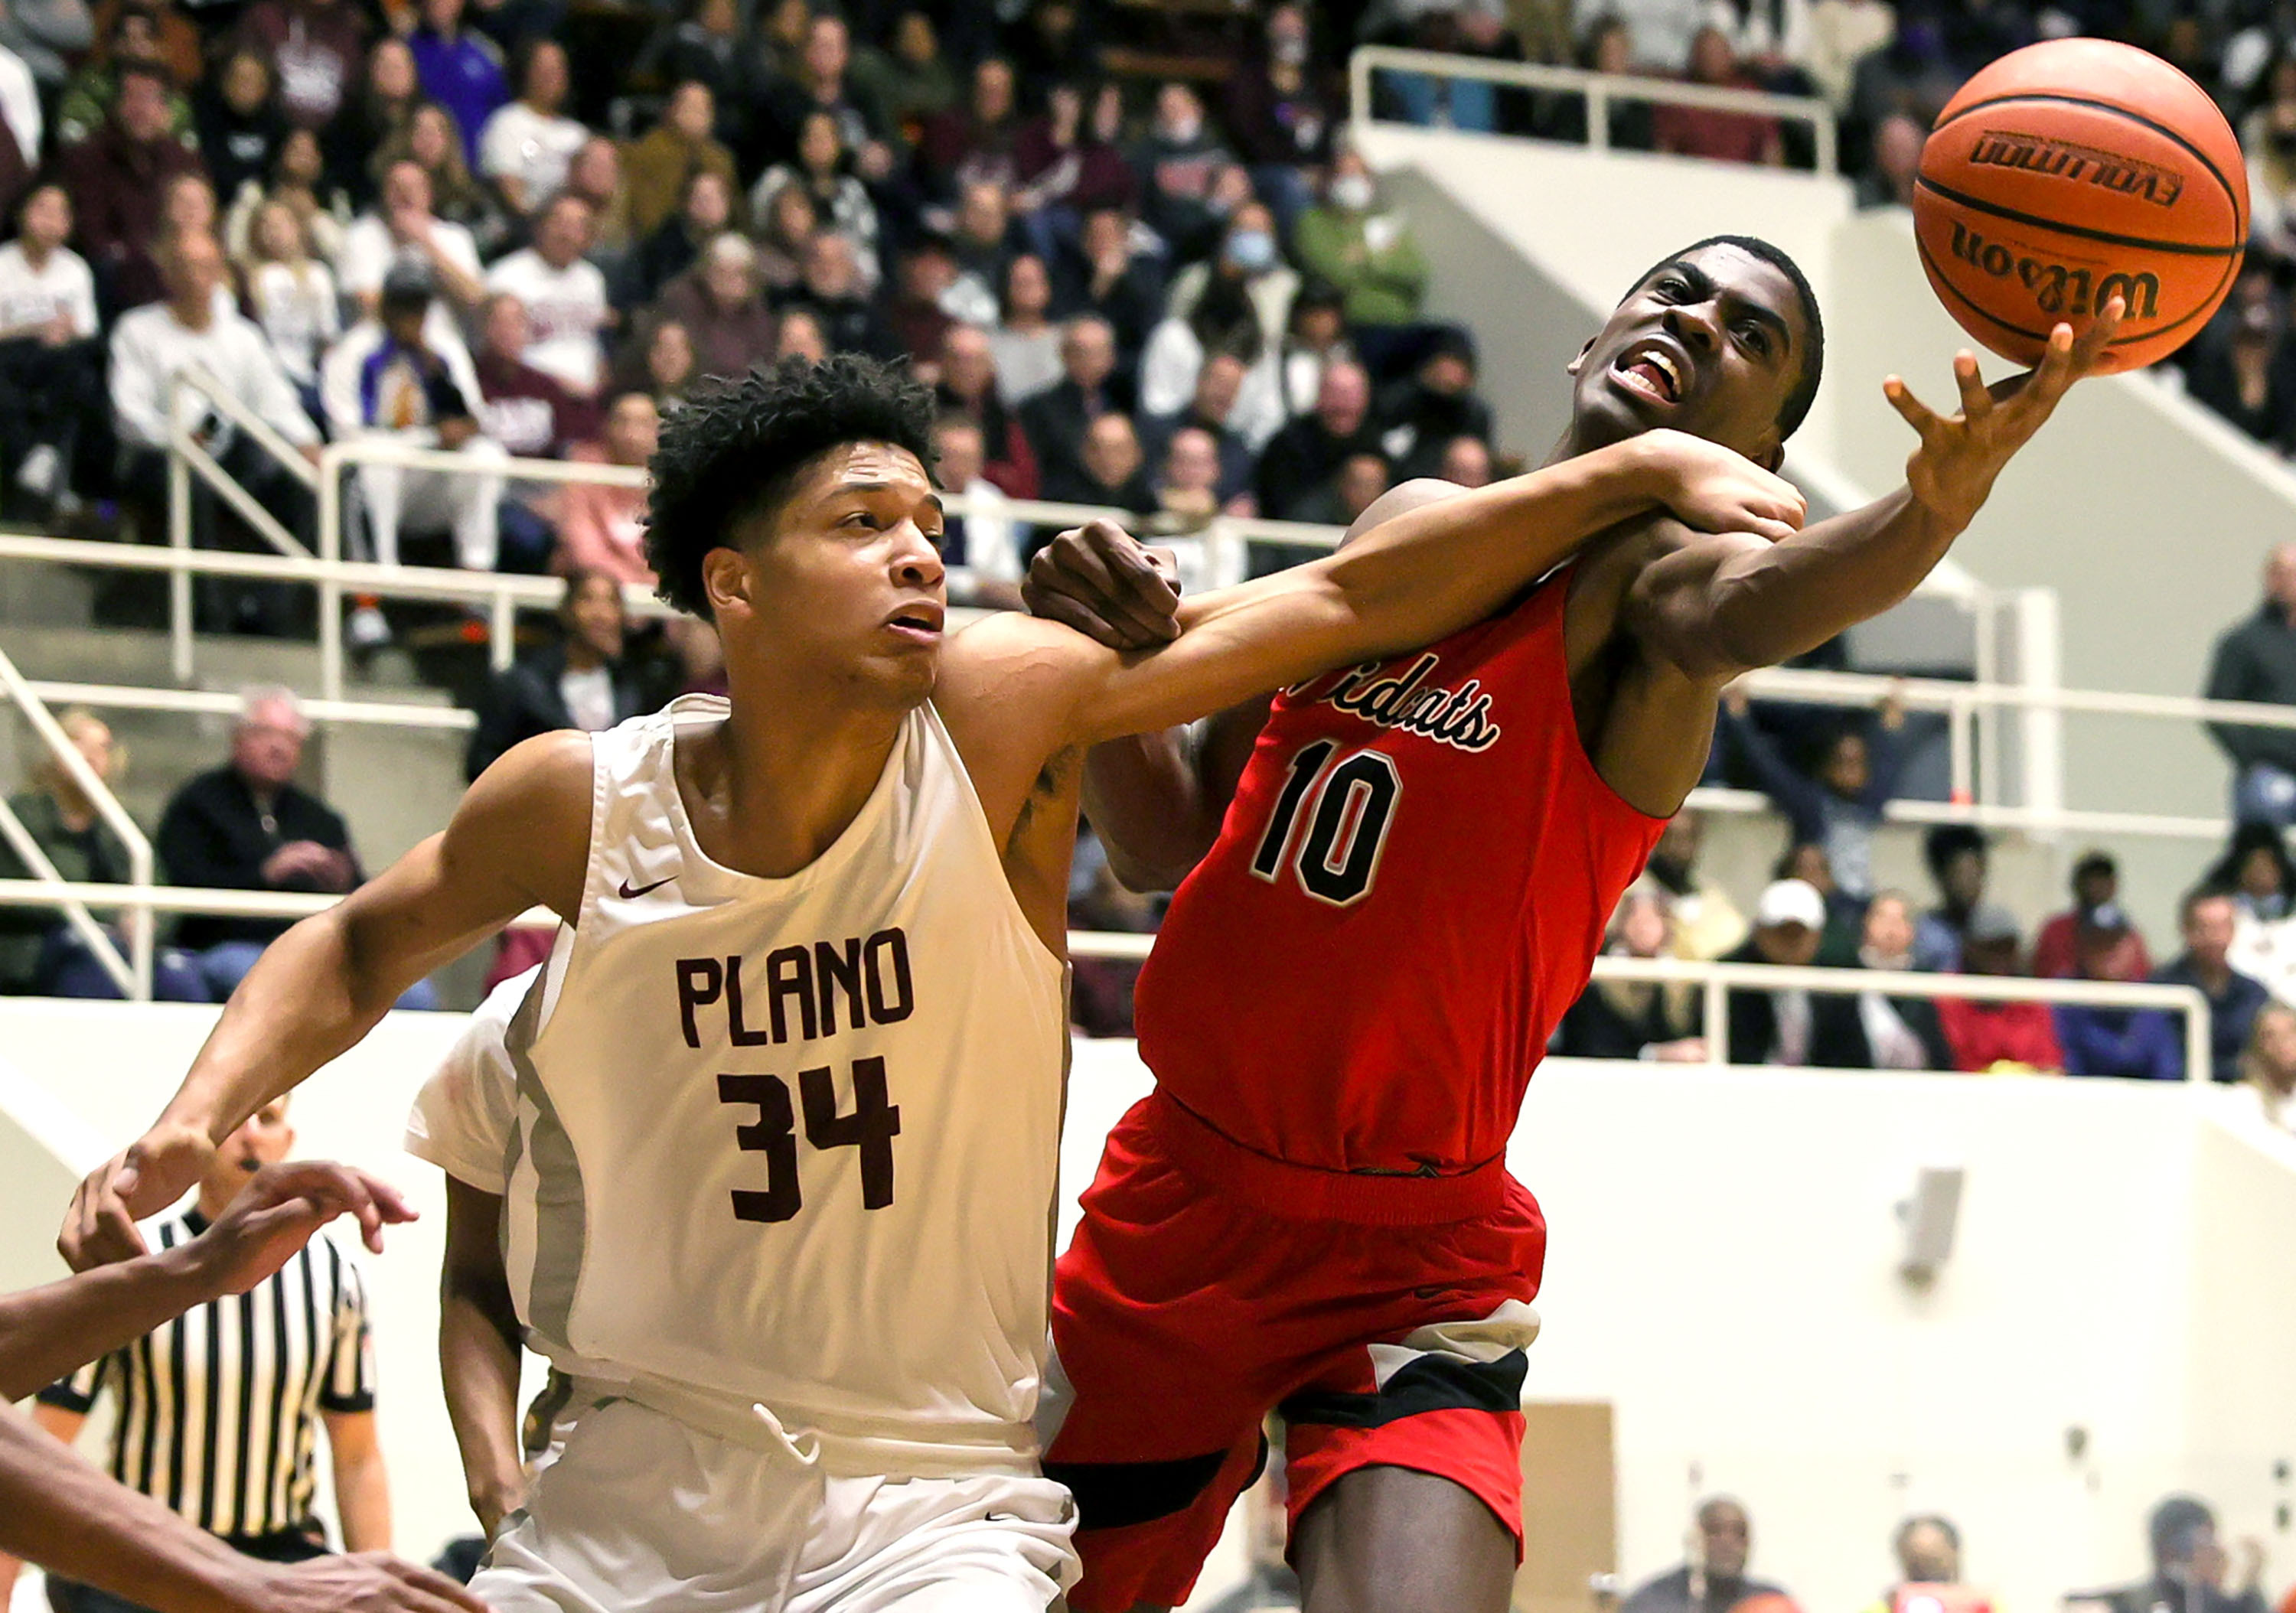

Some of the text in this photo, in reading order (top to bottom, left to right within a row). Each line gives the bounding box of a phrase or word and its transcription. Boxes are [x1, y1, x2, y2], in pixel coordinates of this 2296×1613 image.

[1968, 131, 2184, 207] EVOLUTION
[1949, 218, 2161, 320] Wilson
[1249, 738, 1404, 908] 10
[676, 927, 914, 1048] PLANO
[717, 1055, 901, 1223] 34
